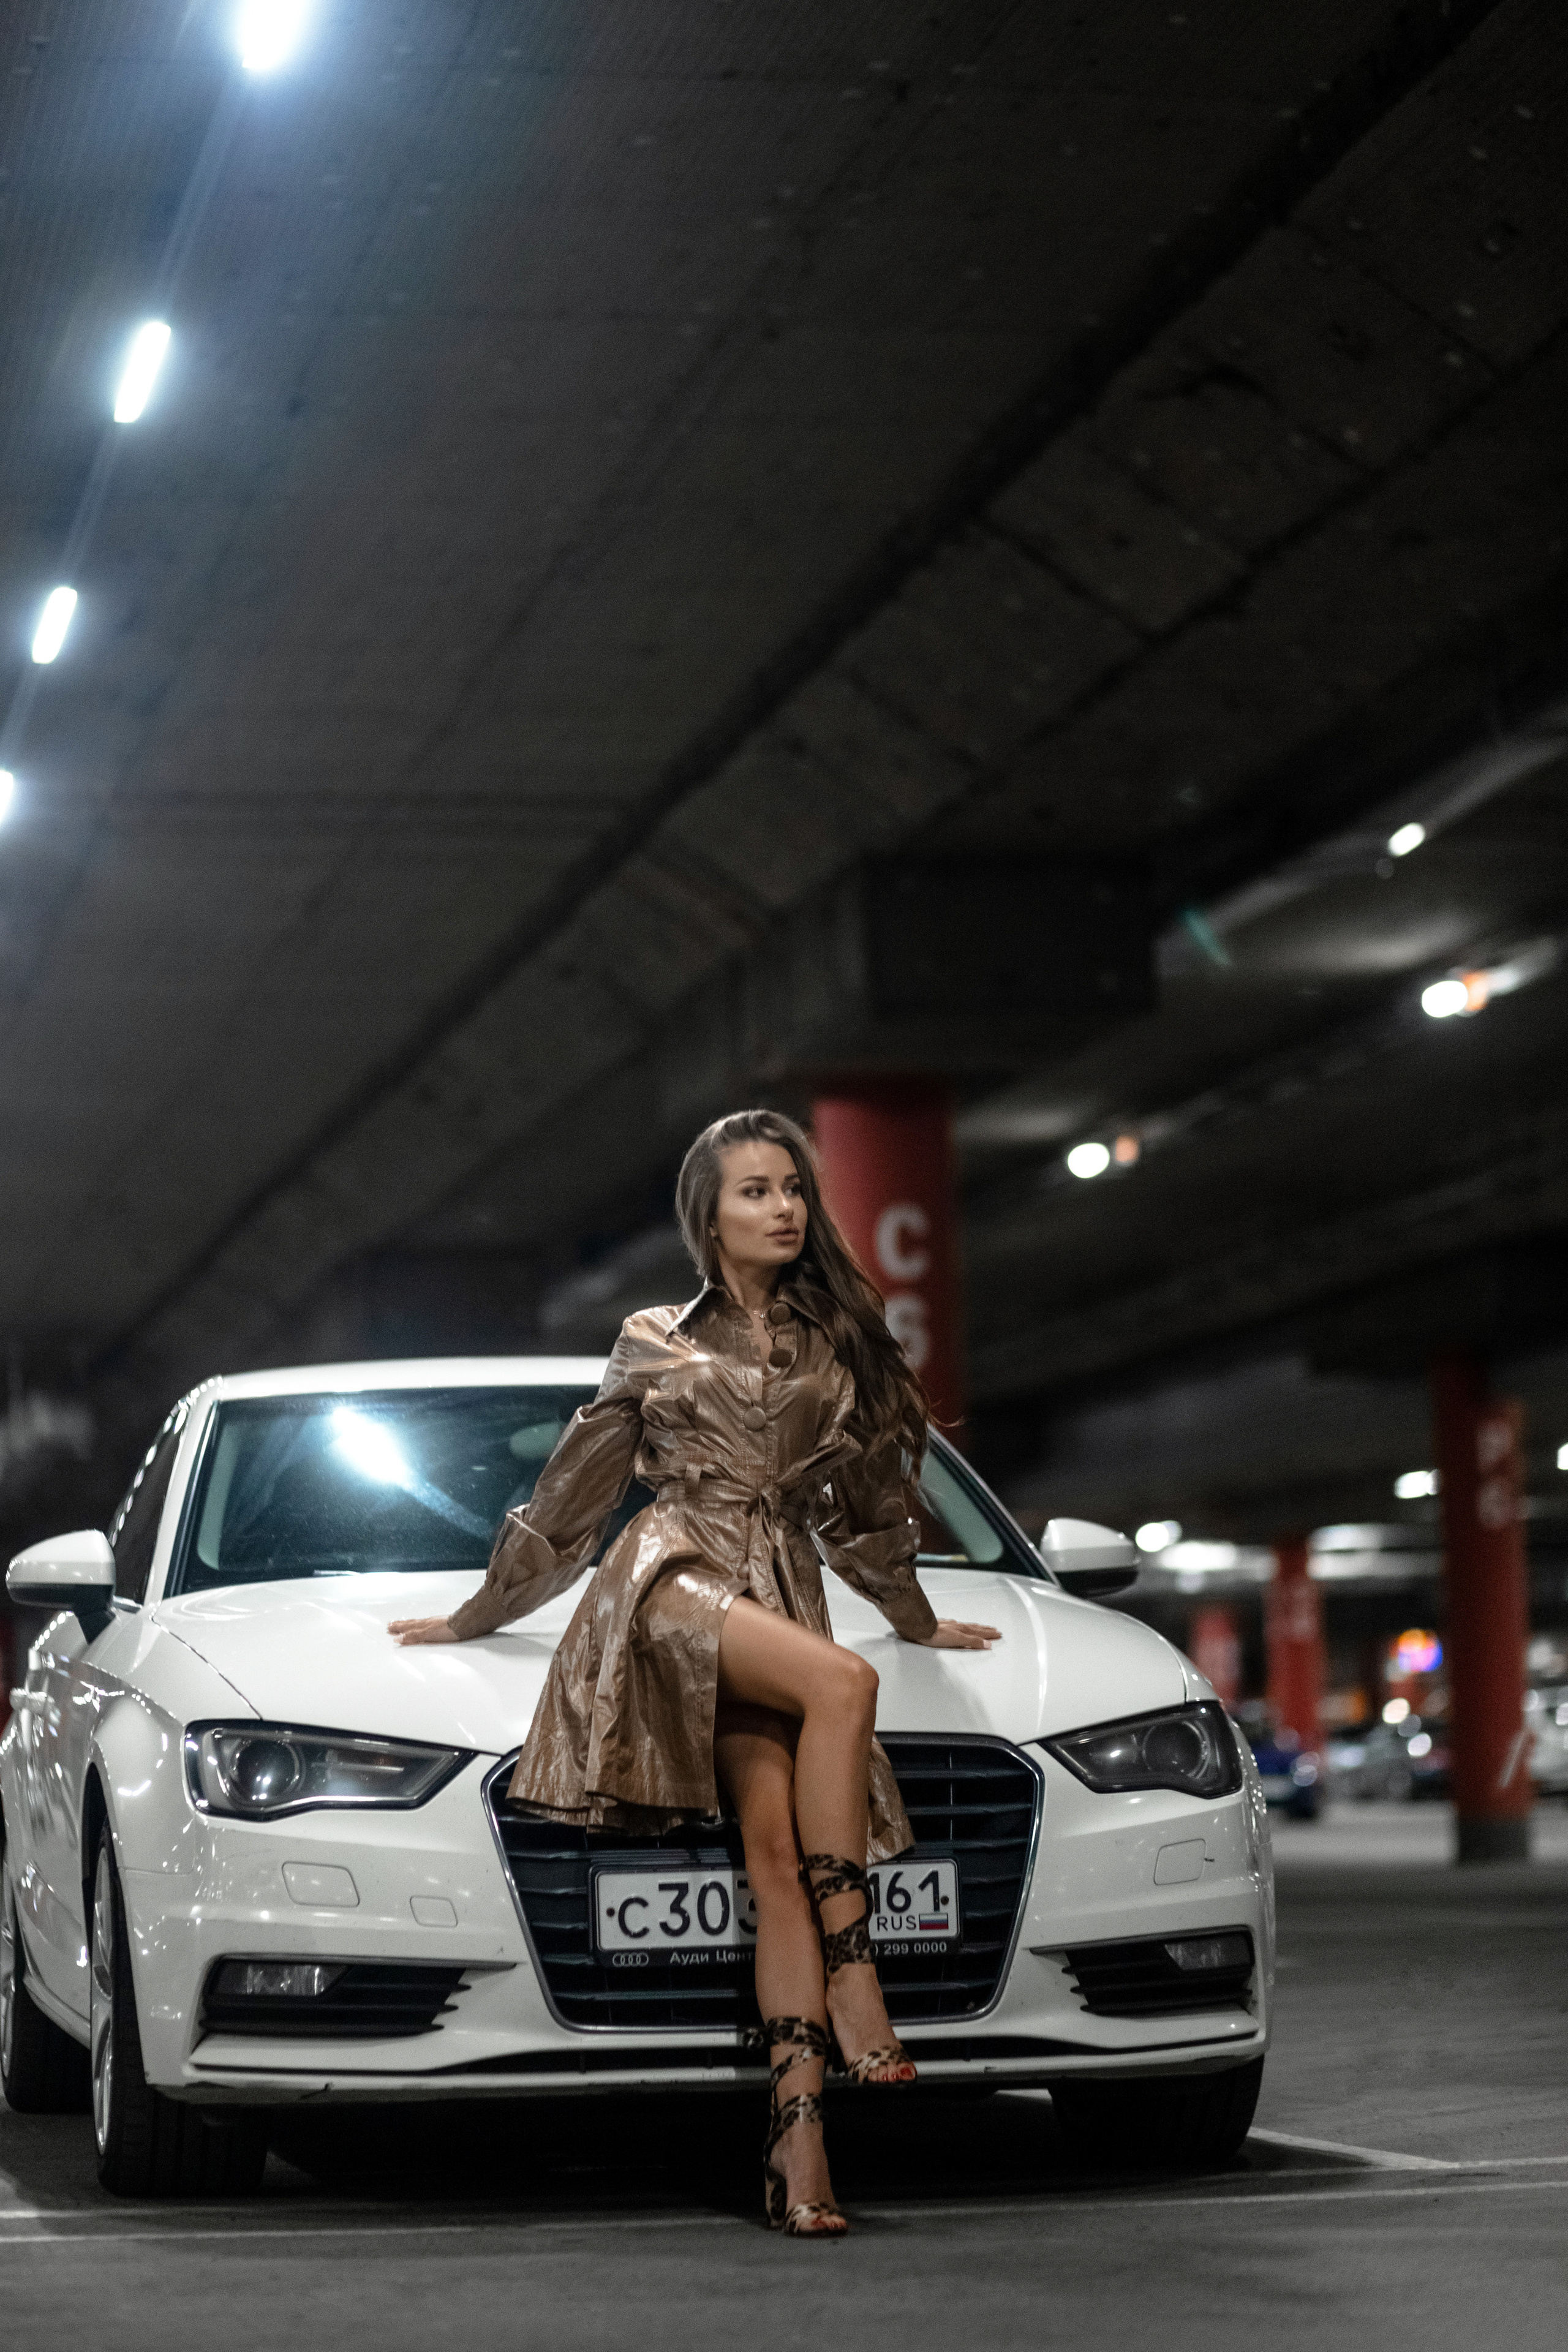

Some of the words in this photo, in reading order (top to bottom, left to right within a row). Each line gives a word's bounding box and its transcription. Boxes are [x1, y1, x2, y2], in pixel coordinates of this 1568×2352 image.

[876, 1203, 929, 1281] C
[868, 1869, 940, 1914] 161
[876, 1915, 916, 1932] RUS
[670, 1951, 709, 1966] Ауди
[884, 1943, 909, 1956] 299
[913, 1941, 947, 1954] 0000
